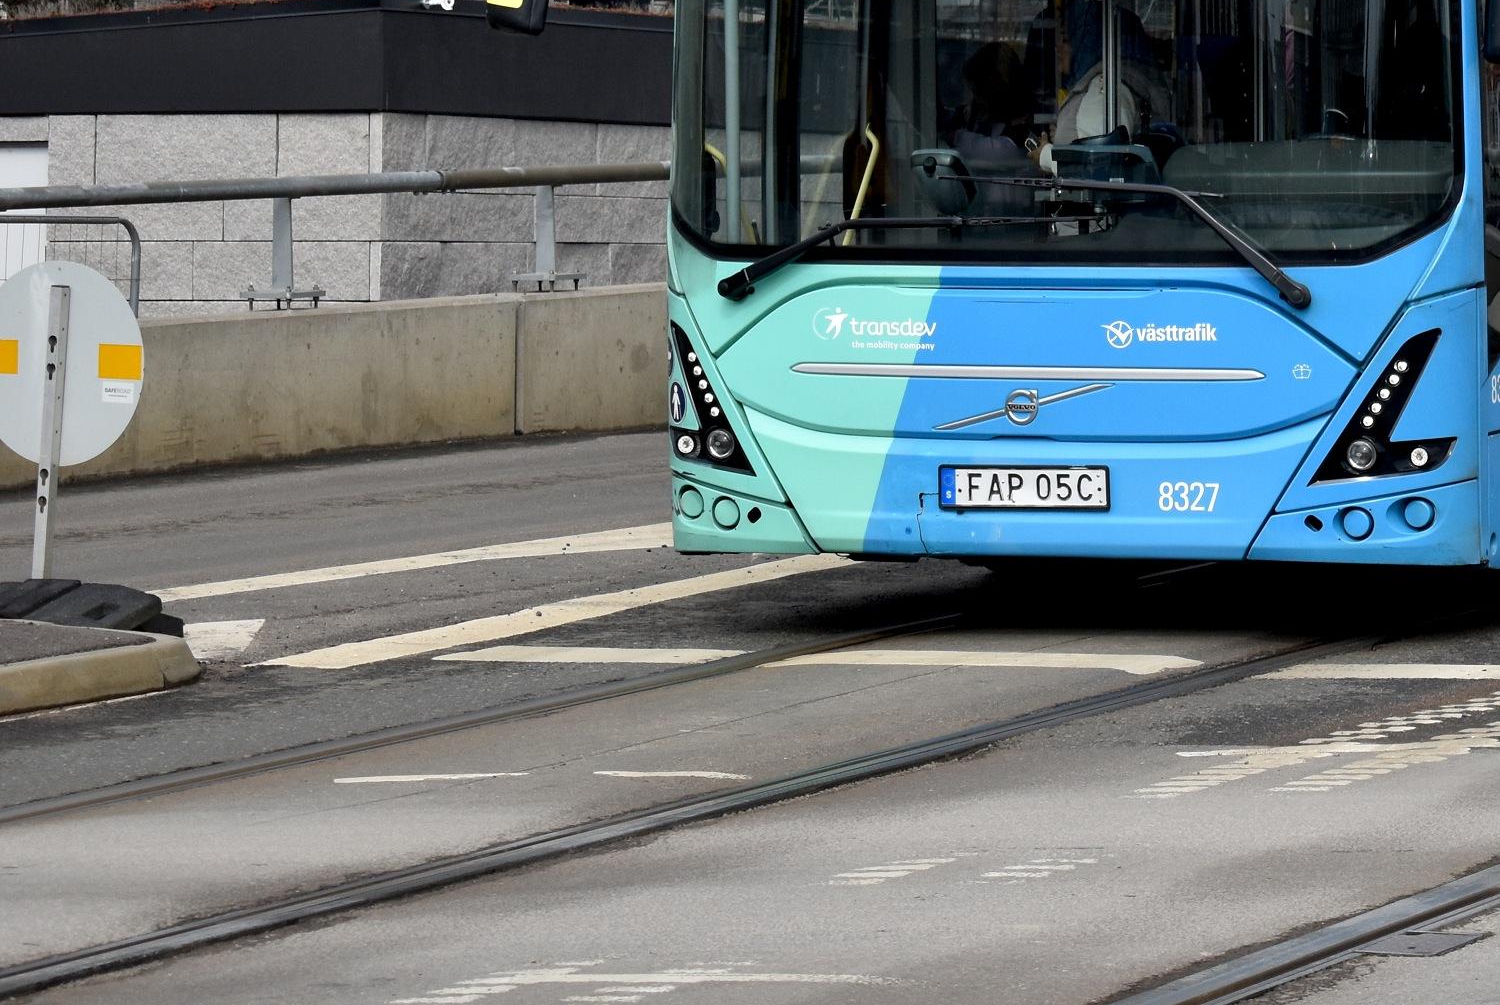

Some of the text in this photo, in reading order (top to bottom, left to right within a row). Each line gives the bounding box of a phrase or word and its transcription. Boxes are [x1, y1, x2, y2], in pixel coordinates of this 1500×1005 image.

[849, 317, 937, 337] transdev
[1136, 323, 1218, 342] västtrafik
[851, 340, 936, 351] the mobility company
[1007, 403, 1036, 411] VOLVO
[945, 490, 952, 499] S
[967, 473, 1024, 502] FAP
[1158, 481, 1220, 513] 8327
